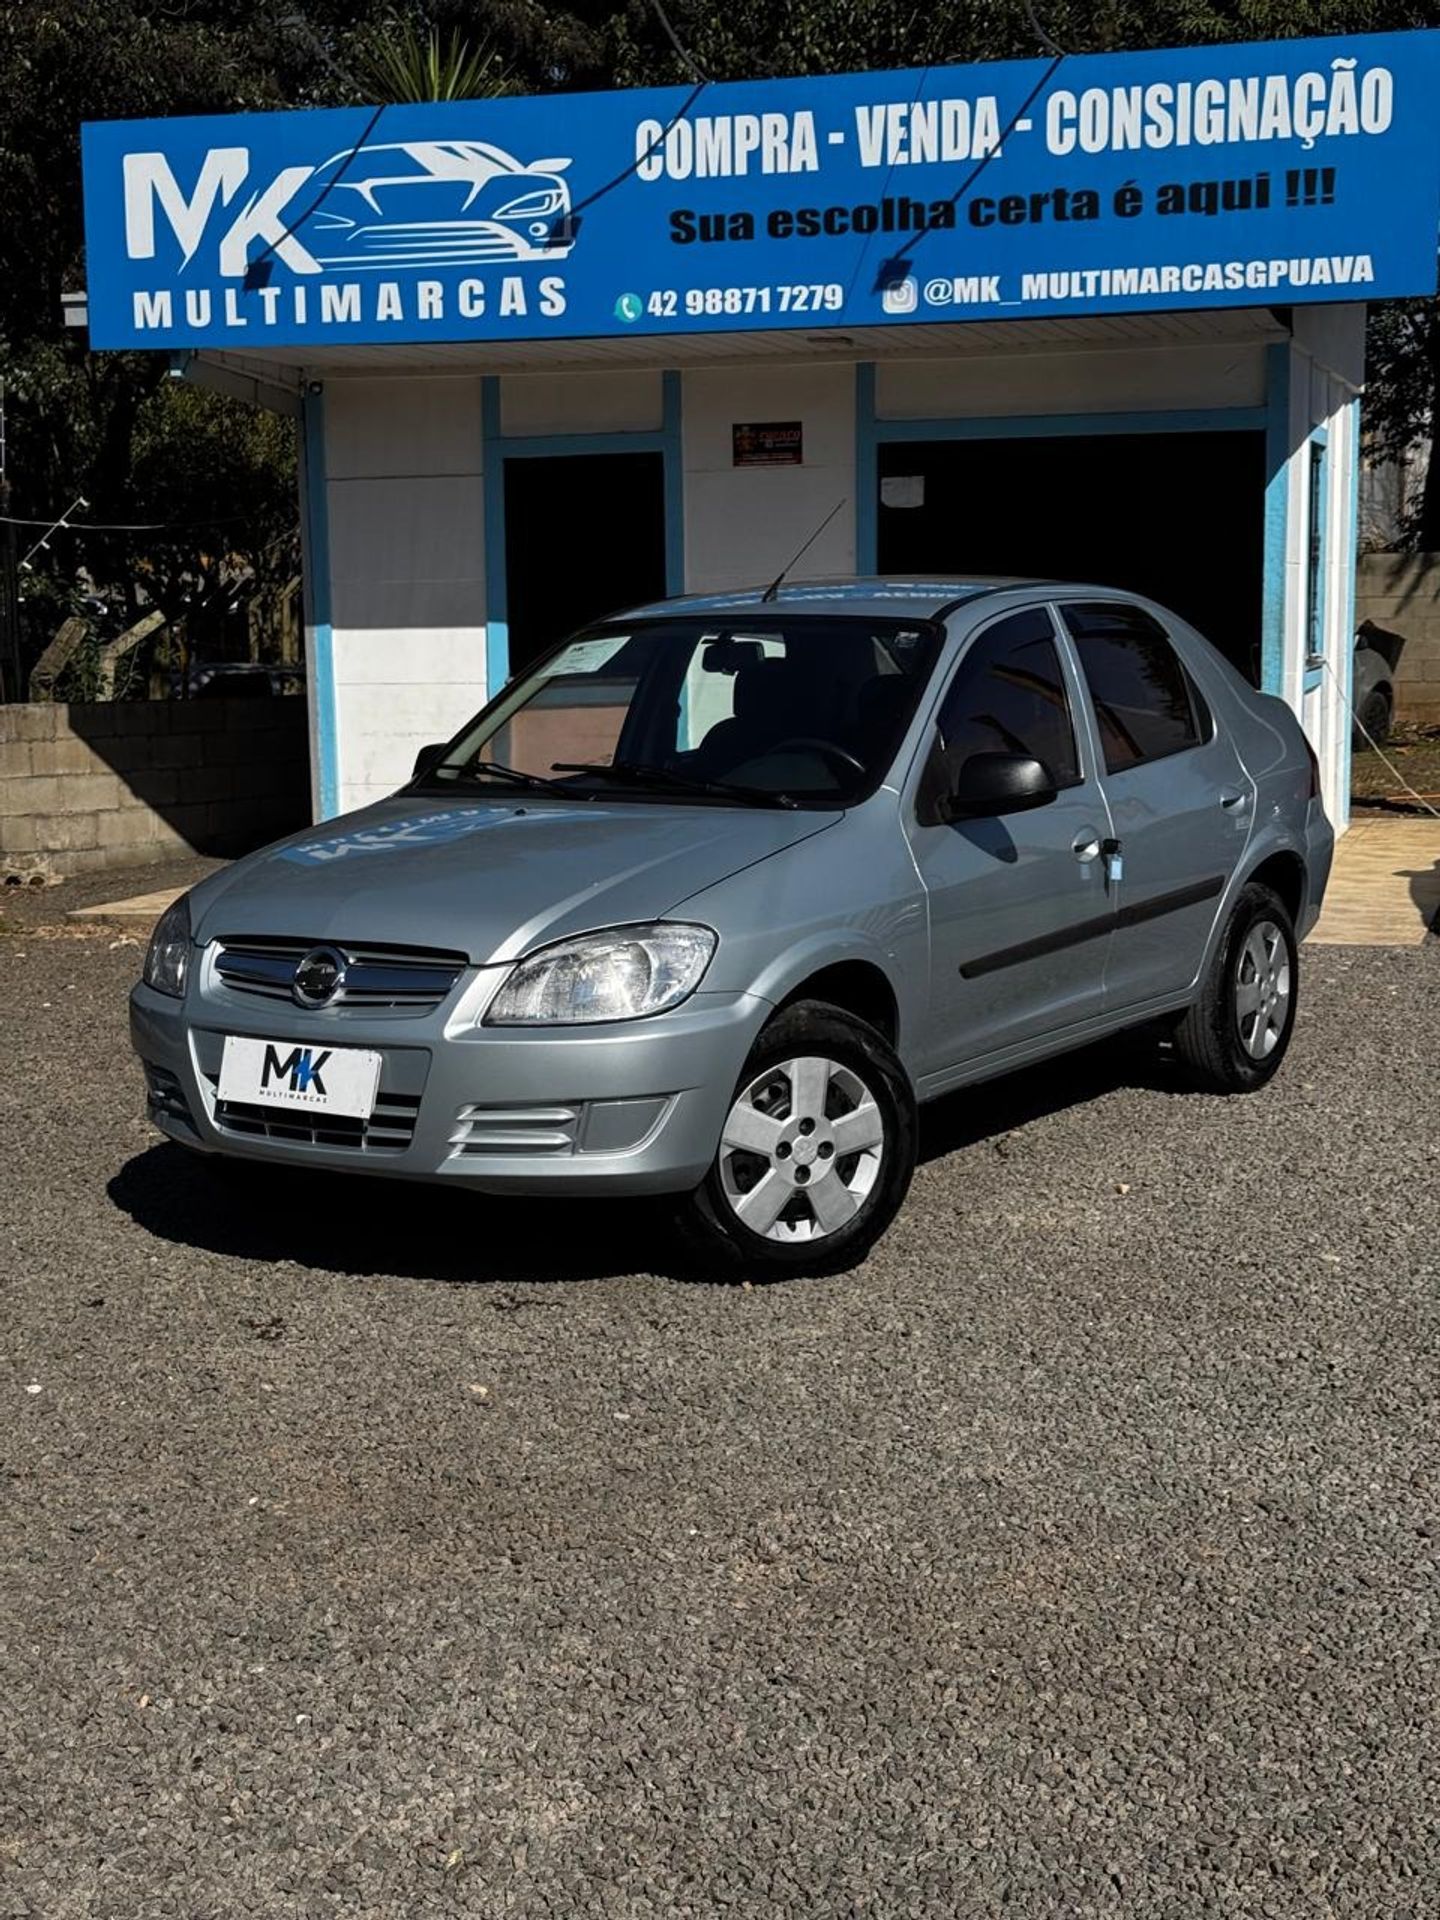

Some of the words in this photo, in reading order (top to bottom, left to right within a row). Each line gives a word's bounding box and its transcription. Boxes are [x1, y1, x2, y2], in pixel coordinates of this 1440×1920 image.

[635, 110, 819, 181] COMPRA
[855, 96, 1002, 167] VENDA
[1046, 57, 1394, 155] CONSIGNAÇÃO
[122, 146, 323, 276] MK
[669, 208, 755, 245] Sua
[767, 194, 955, 239] escolha
[967, 184, 1101, 226] certa
[1113, 181, 1143, 218] é
[1156, 172, 1271, 217] aqui
[1285, 166, 1337, 208] !!!
[133, 275, 567, 330] MULTIMARCAS
[647, 290, 679, 317] 42
[685, 287, 771, 316] 98871
[777, 283, 844, 312] 7279
[258, 1089, 329, 1104] MULTIMARCAS
[260, 1043, 333, 1096] MK
